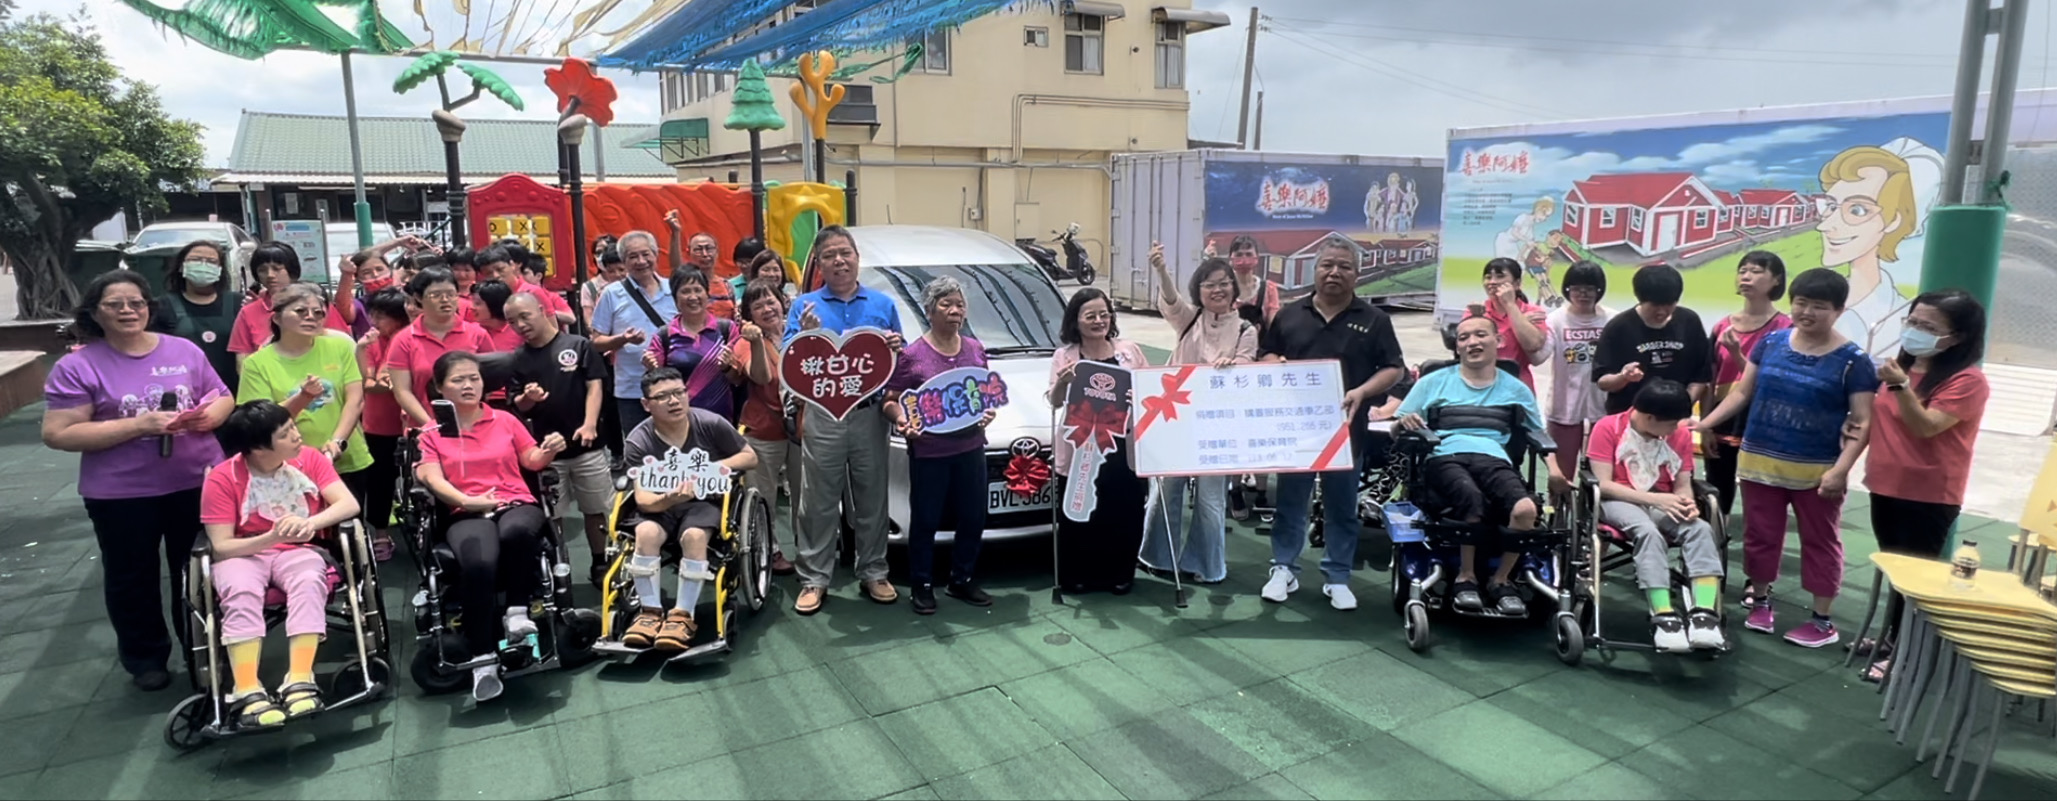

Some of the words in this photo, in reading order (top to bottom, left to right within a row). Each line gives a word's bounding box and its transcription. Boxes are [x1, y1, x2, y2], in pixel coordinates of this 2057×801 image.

[812, 375, 863, 398] 的愛
[1209, 372, 1322, 390] 蘇杉卿先生
[663, 449, 709, 472] 喜樂
[697, 477, 729, 498] you
